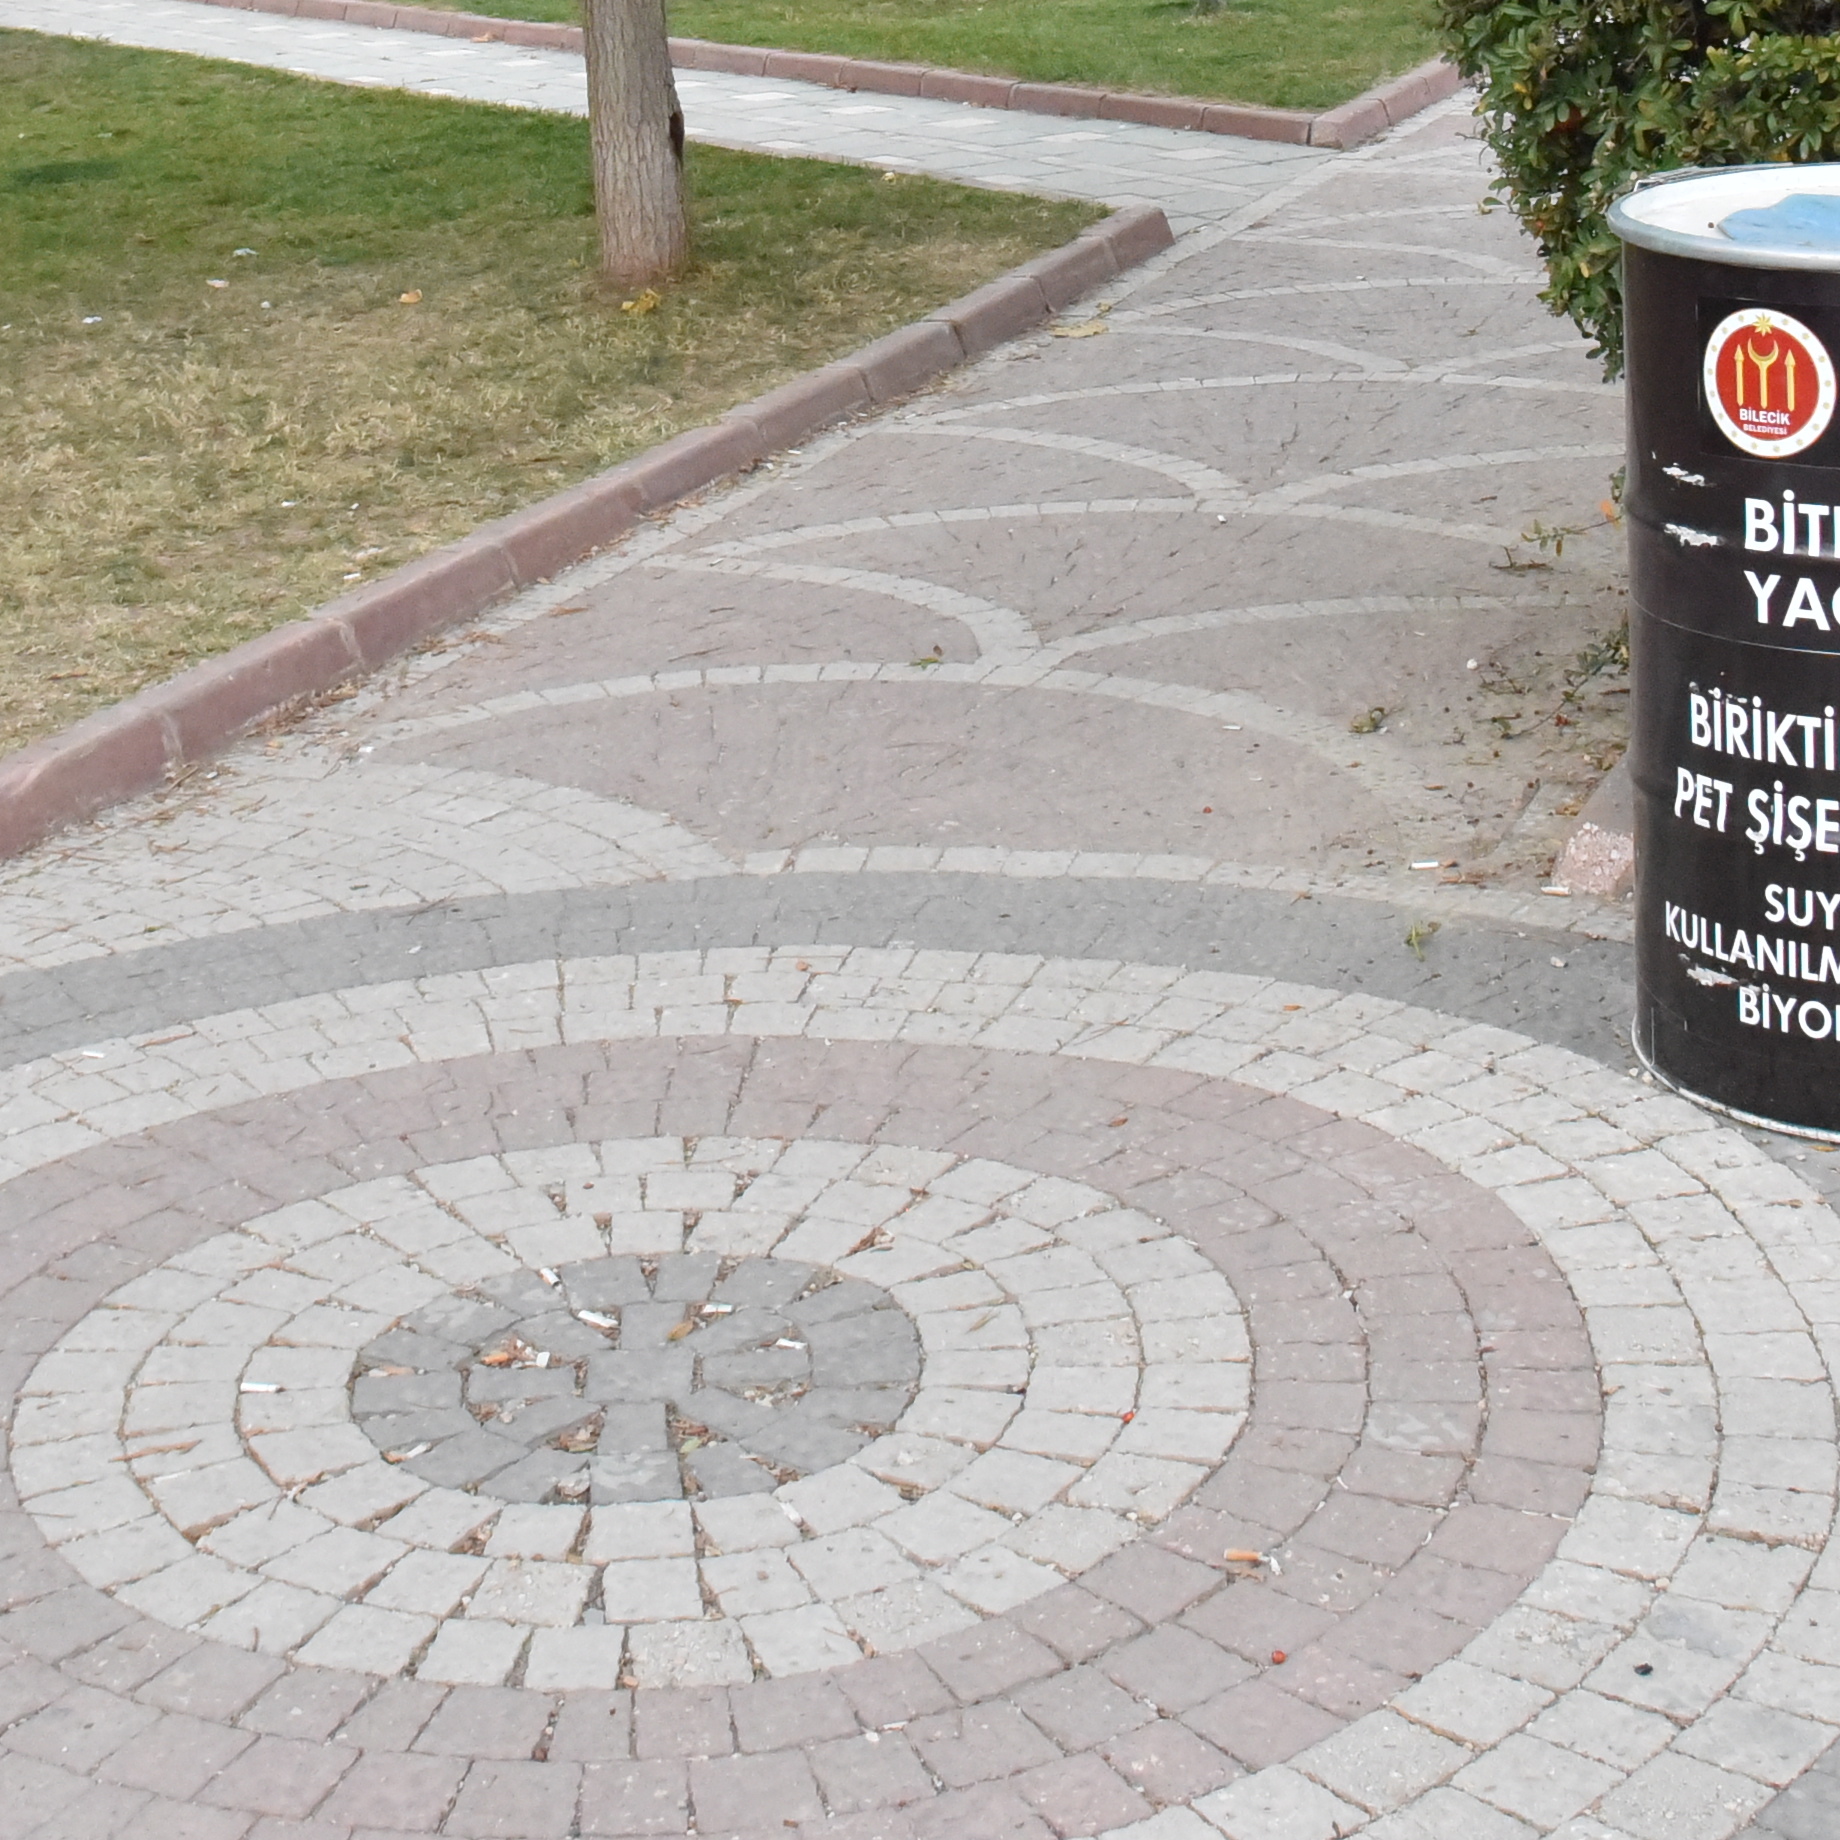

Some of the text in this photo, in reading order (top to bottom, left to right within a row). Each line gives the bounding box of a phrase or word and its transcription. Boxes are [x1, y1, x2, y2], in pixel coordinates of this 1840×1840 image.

[1739, 406, 1791, 426] BİLECİK
[1742, 423, 1788, 436] BELEDİYESİ
[1674, 766, 1734, 834] PET
[1745, 779, 1840, 862] ŞİŞE
